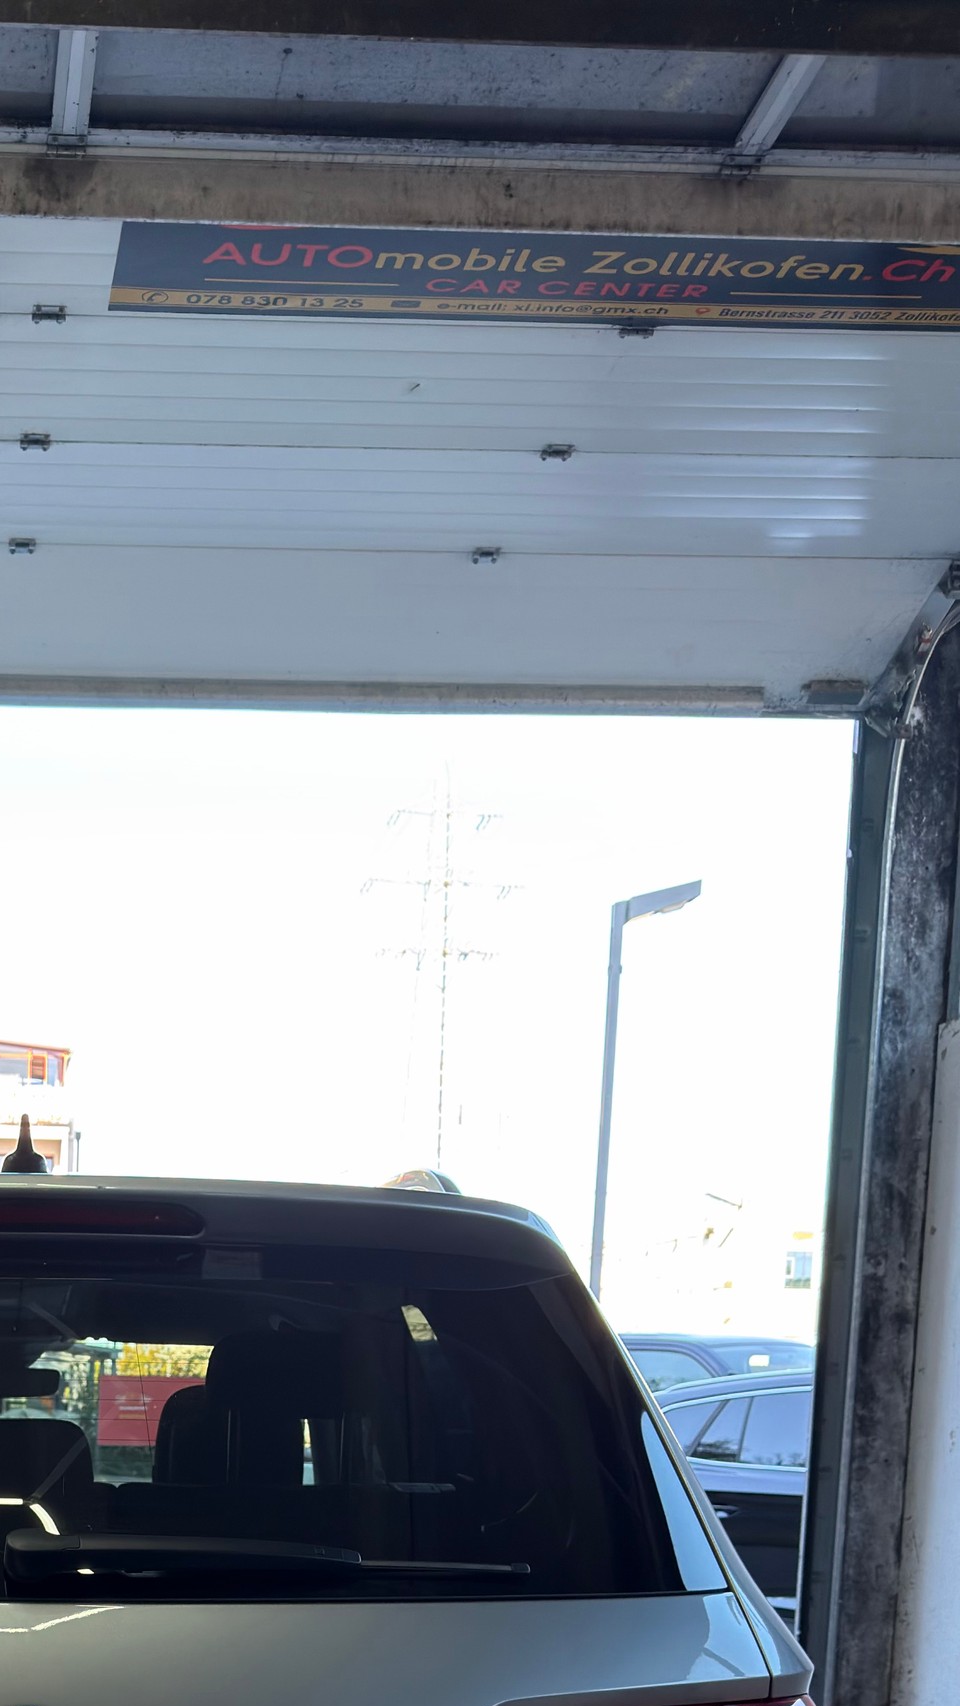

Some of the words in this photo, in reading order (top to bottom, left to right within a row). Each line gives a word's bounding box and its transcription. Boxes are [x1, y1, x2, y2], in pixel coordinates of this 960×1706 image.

[202, 241, 566, 274] AUTOmobile
[583, 250, 956, 283] Zollikofen.Ch
[425, 277, 521, 295] CAR
[537, 280, 709, 299] CENTER
[186, 293, 232, 305] 078
[300, 297, 324, 307] 13
[333, 298, 364, 308] 25
[718, 307, 814, 320] Bernstrasse
[848, 311, 890, 321] 3052
